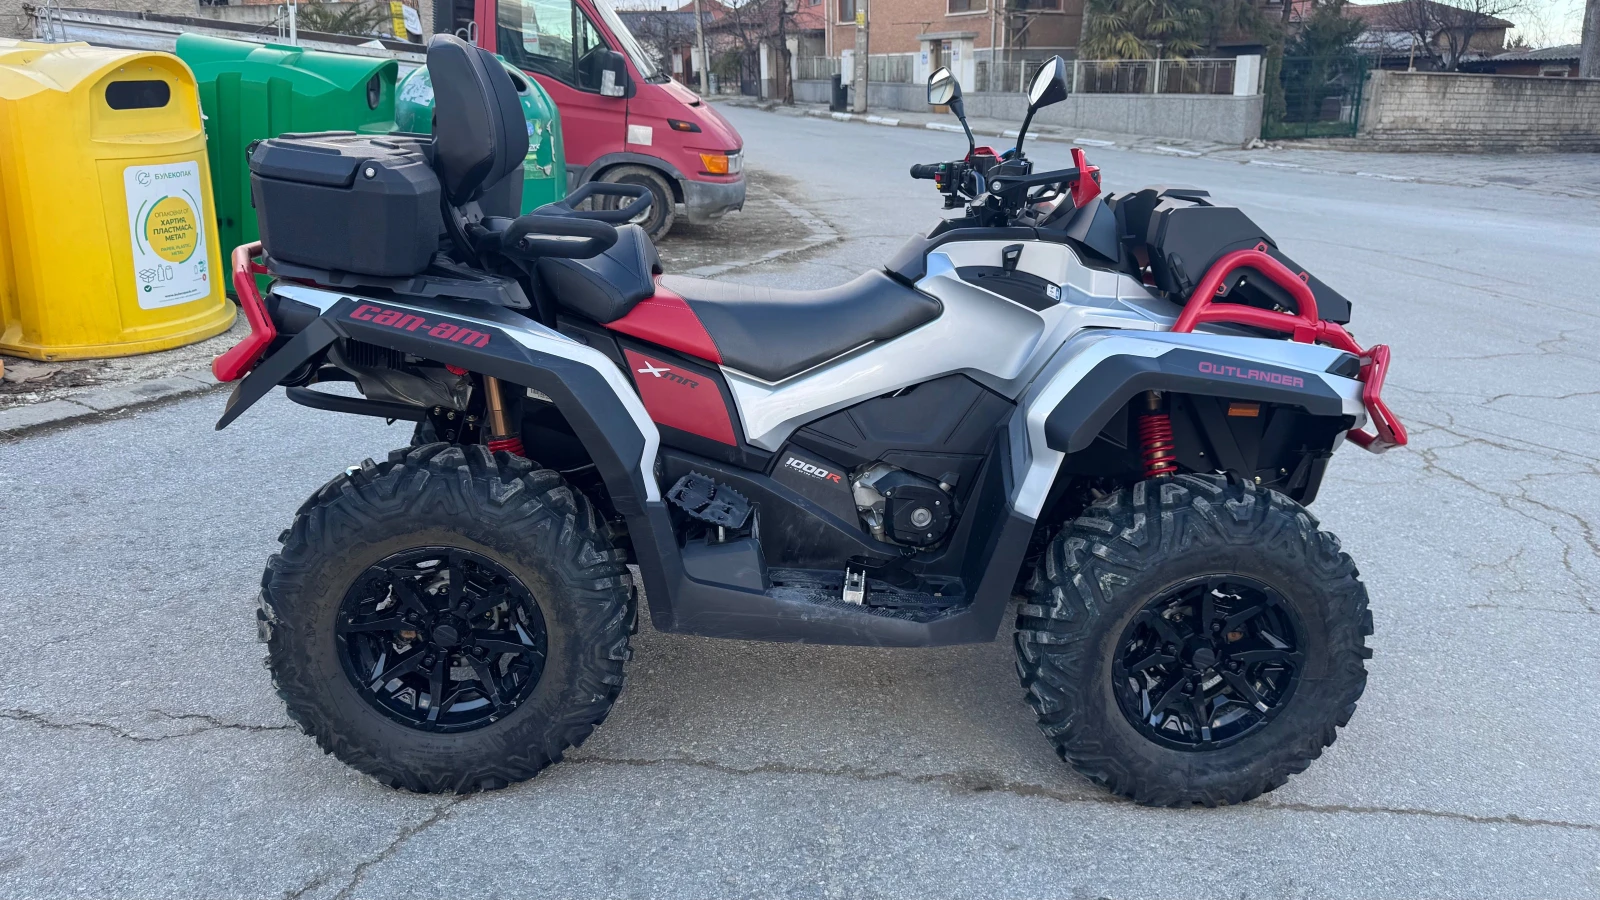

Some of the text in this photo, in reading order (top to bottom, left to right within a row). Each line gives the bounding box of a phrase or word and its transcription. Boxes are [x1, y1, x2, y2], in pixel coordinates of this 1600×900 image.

[154, 170, 192, 180] БУЛЕКОПАК
[165, 233, 186, 242] МЕТАЛ
[349, 304, 491, 348] can-am
[1198, 361, 1304, 388] OUTLANDER
[785, 457, 842, 483] 1000R
